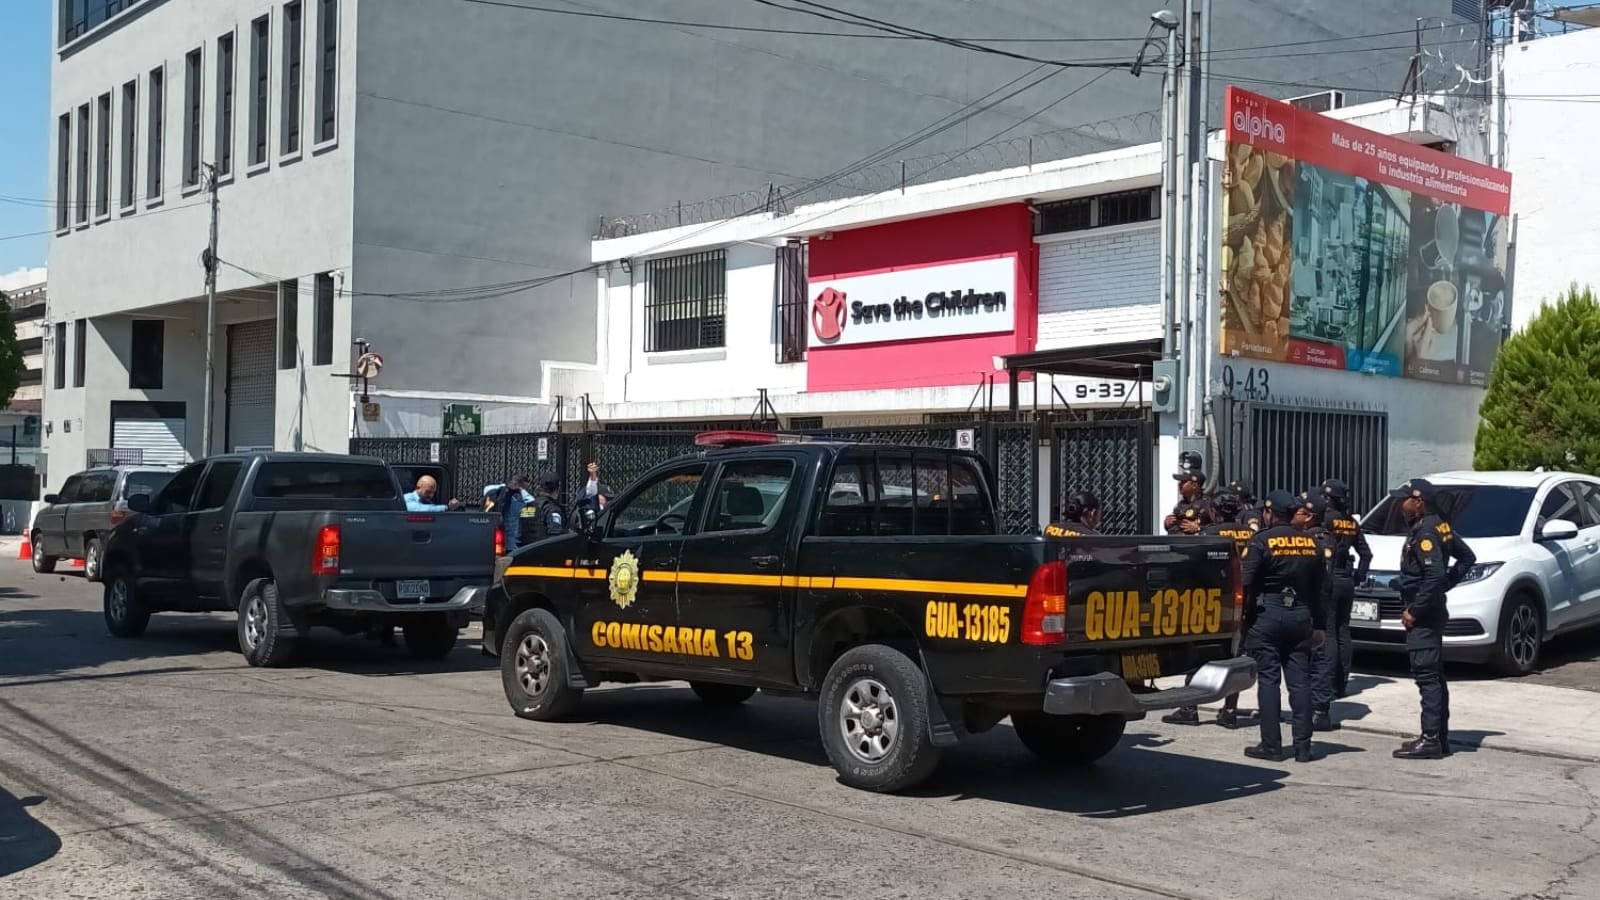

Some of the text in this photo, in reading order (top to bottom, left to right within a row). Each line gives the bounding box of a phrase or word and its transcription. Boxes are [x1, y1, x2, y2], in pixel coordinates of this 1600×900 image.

[1233, 105, 1286, 145] alpha
[1332, 132, 1510, 195] Más de 25 años equipando y profesionalizando
[1378, 161, 1468, 197] la industria alimentaria
[851, 288, 1007, 325] Save the Children
[1075, 383, 1125, 398] 9-33
[1222, 365, 1270, 401] 9-43
[1046, 525, 1085, 537] POLIC
[1267, 536, 1317, 548] POLICIA
[926, 600, 1010, 644] GUA-13185
[1085, 588, 1222, 641] GUA-13185
[591, 620, 755, 661] COMISARIA 13
